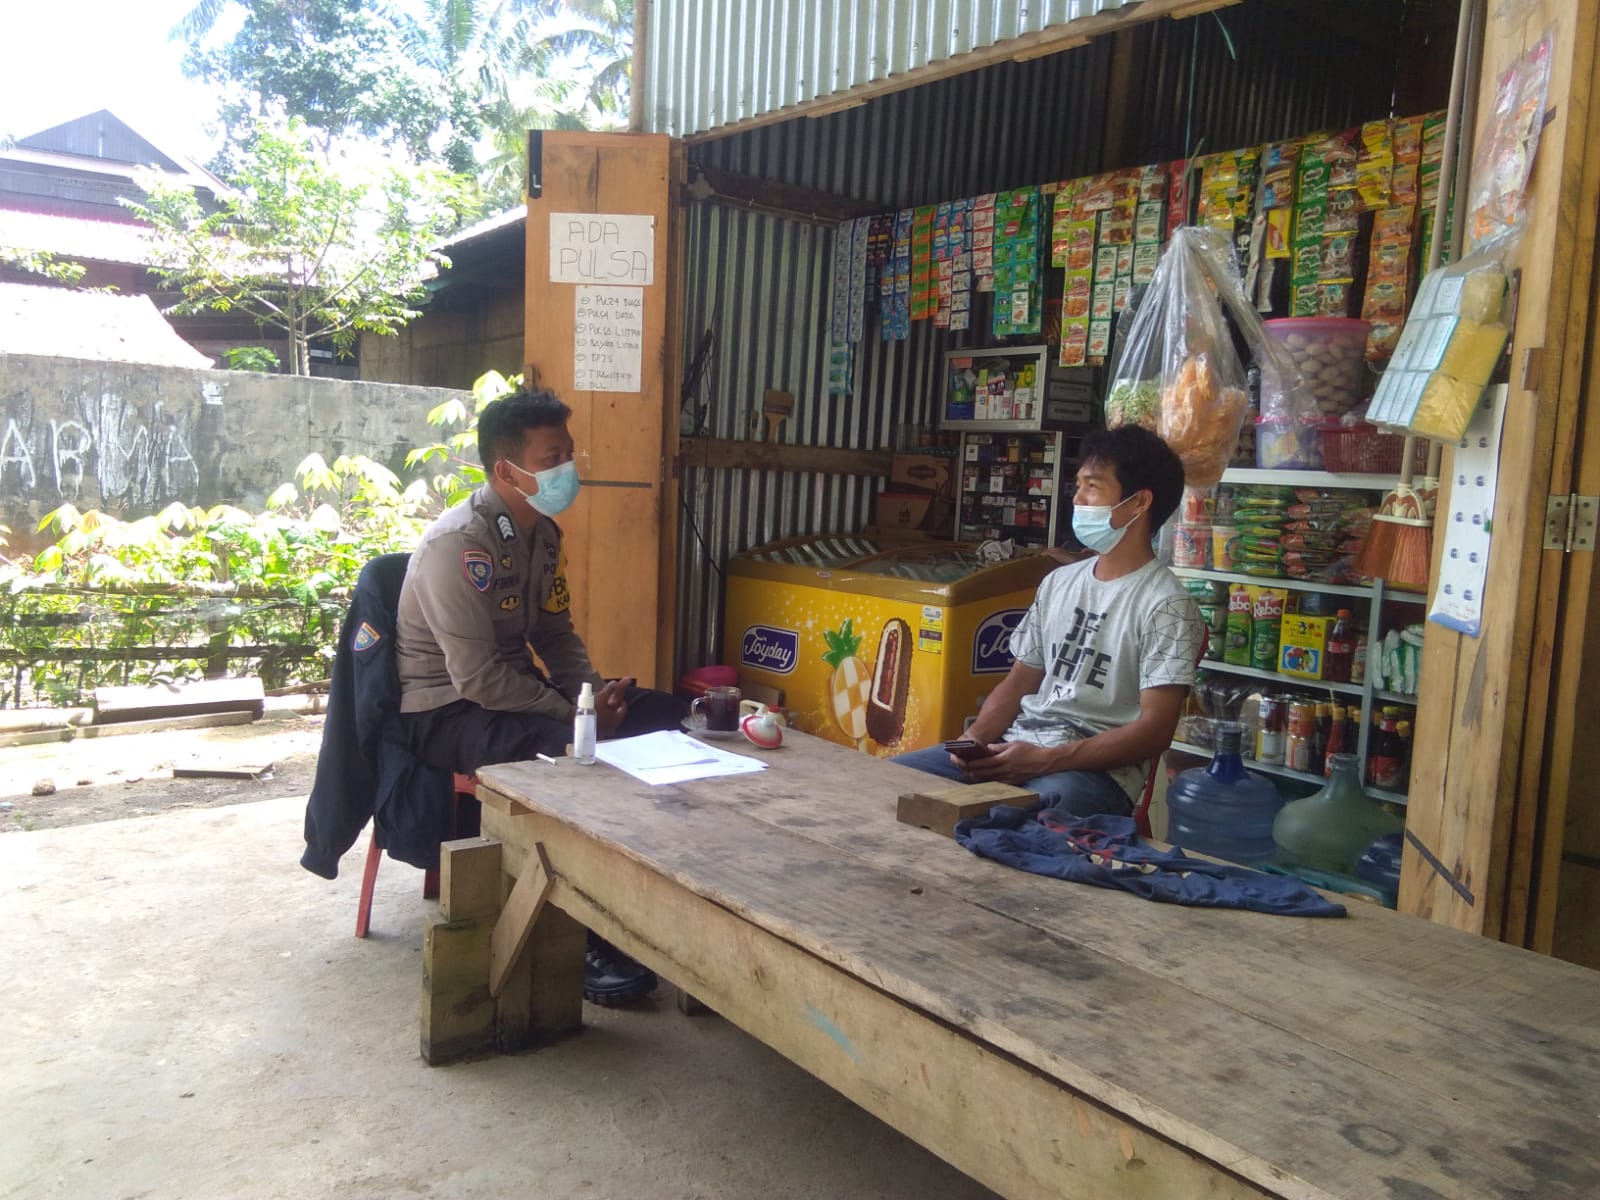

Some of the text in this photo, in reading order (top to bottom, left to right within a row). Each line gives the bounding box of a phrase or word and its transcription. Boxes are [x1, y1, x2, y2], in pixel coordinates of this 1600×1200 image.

[568, 221, 620, 244] ADA
[560, 248, 648, 281] PULSA
[1253, 601, 1282, 618] Rebo
[744, 630, 792, 667] Joyday
